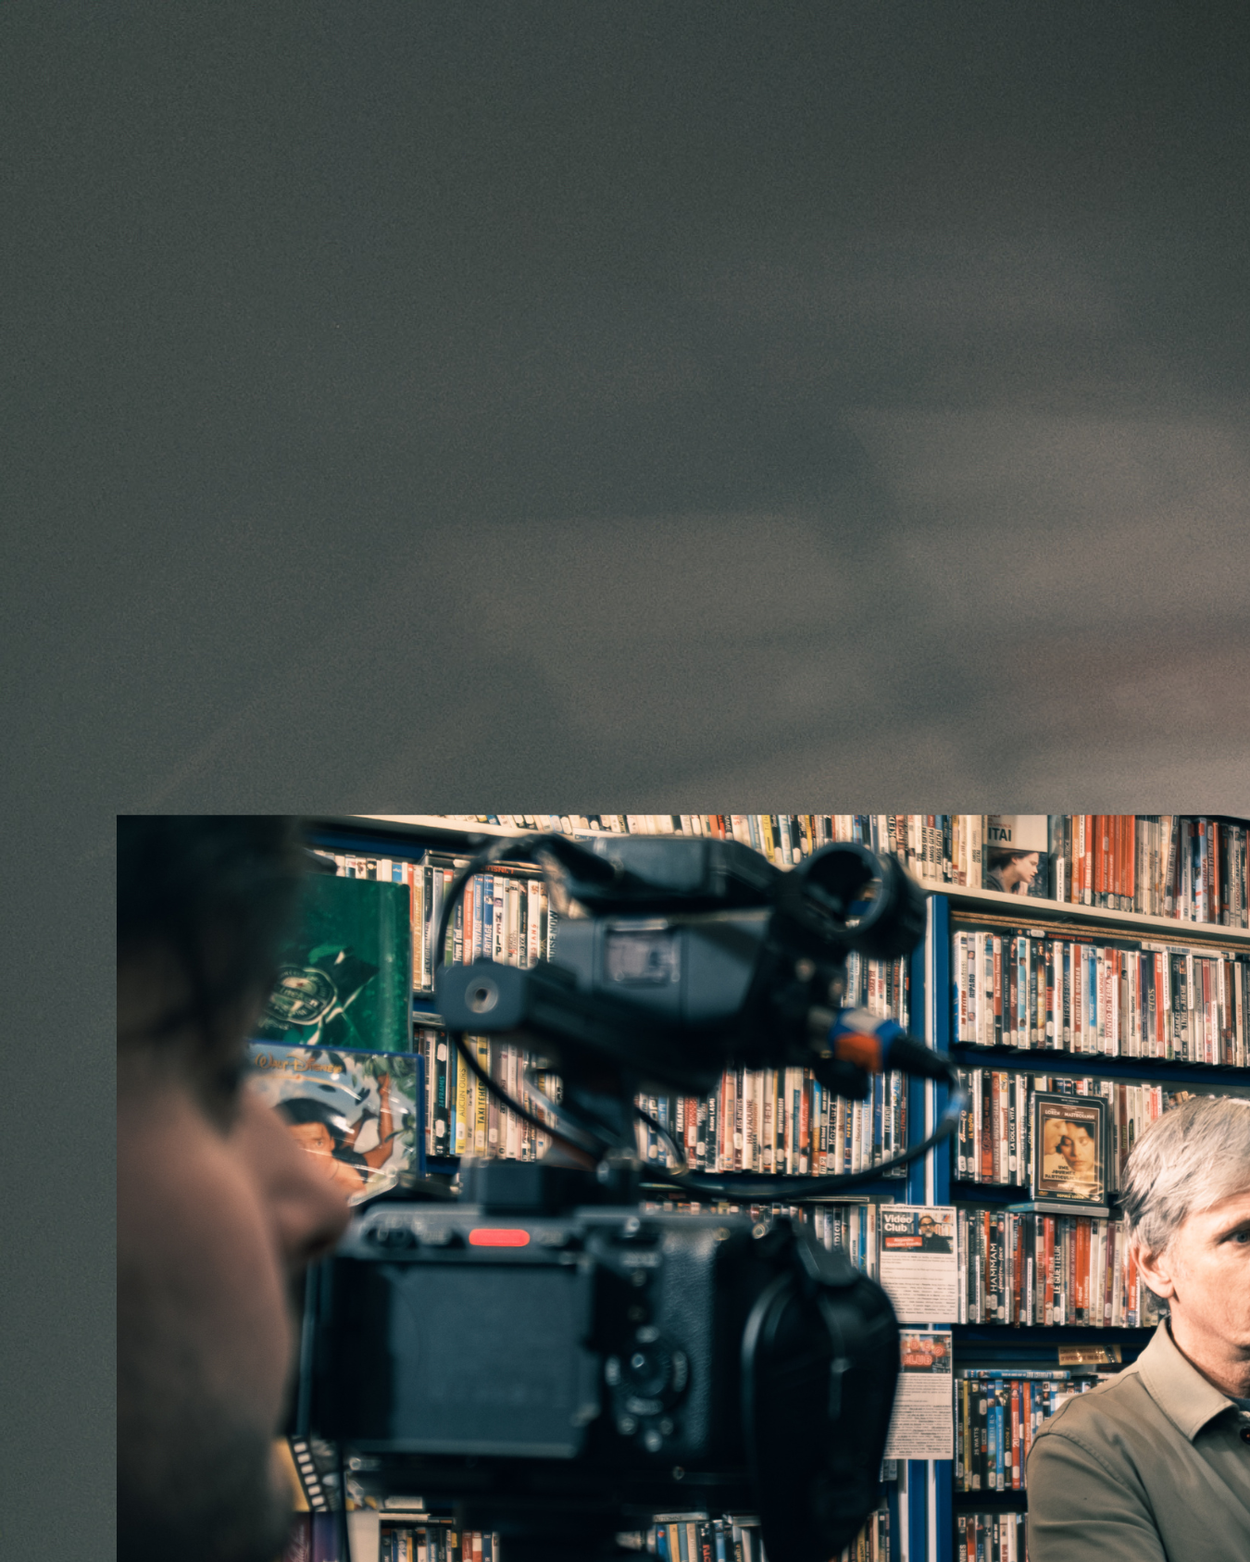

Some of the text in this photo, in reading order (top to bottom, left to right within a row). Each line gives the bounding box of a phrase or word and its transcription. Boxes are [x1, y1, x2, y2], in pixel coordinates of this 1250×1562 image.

[549, 911, 557, 929] NOW
[1010, 1143, 1015, 1151] LA
[884, 1214, 912, 1223] Vidéo
[884, 1223, 907, 1232] Club
[1054, 1285, 1061, 1294] LE
